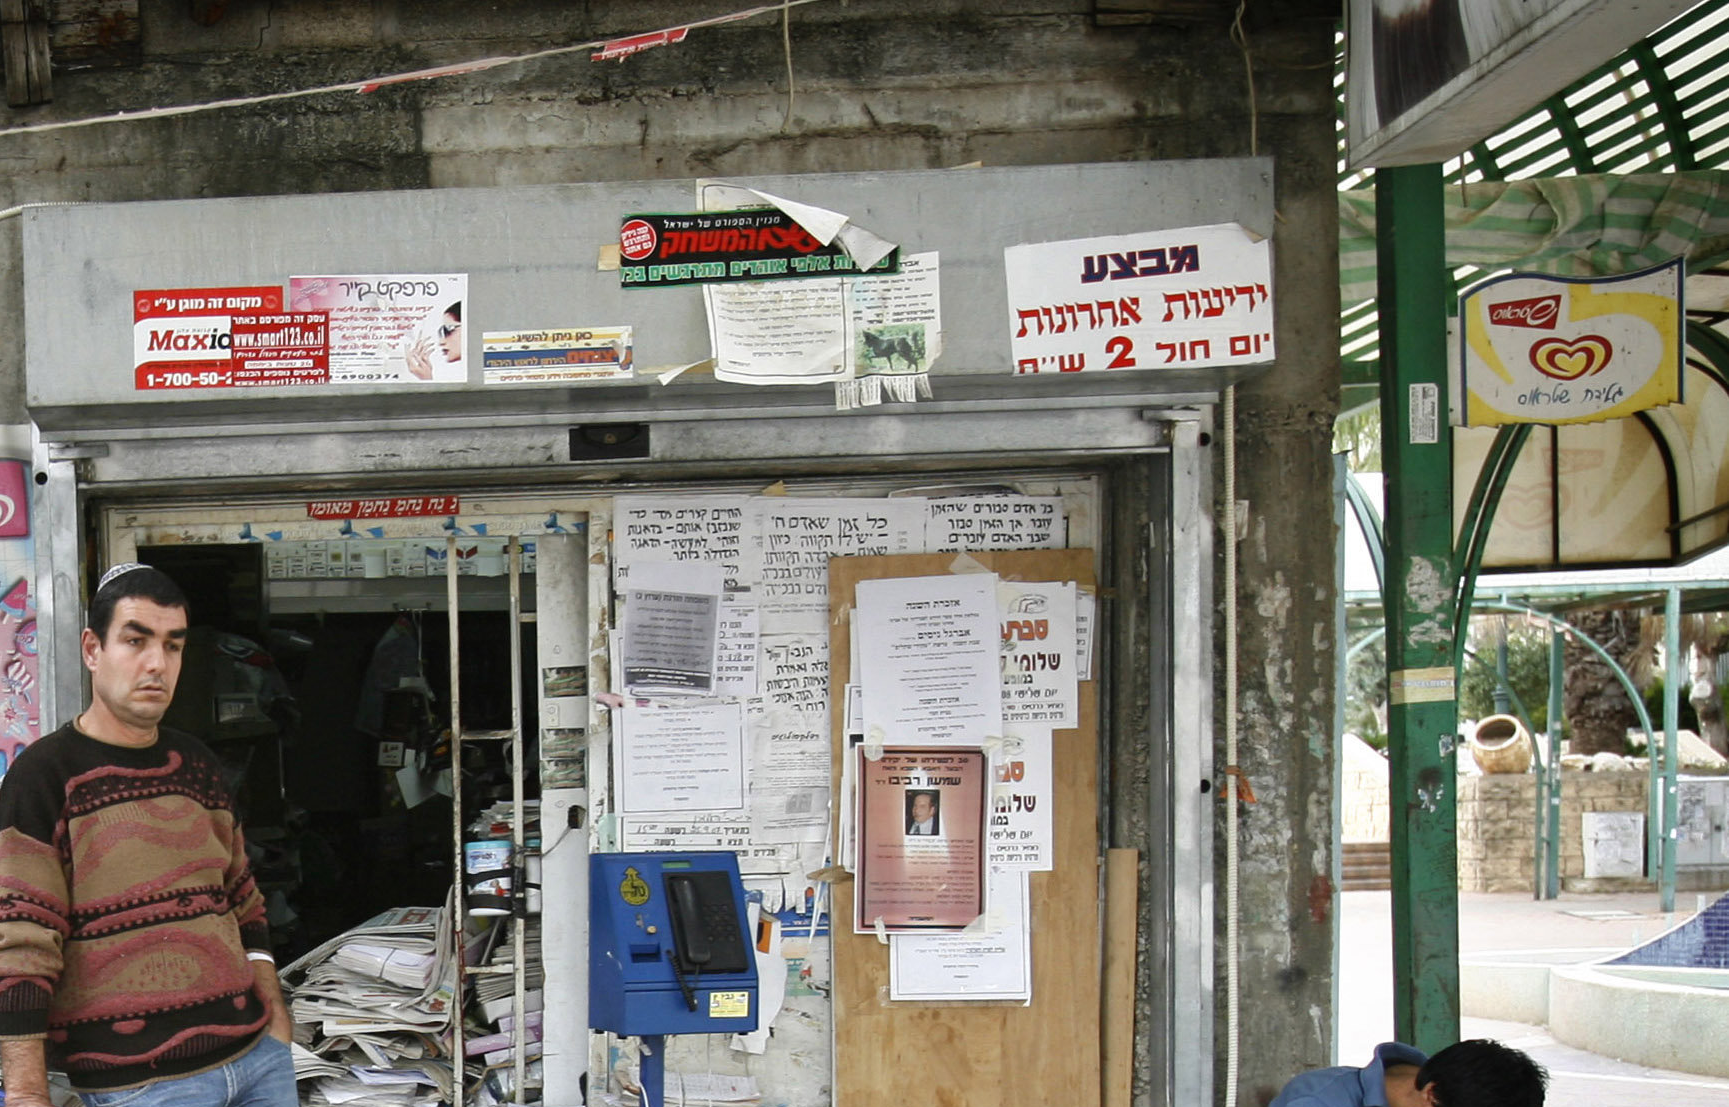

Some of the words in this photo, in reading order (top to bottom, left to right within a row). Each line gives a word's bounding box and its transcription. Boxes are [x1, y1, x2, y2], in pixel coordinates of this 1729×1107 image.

[663, 219, 693, 229] ישראל
[697, 217, 711, 228] של
[1081, 244, 1200, 284] מבצע
[178, 299, 204, 312] מוגן
[207, 298, 223, 309] זה
[226, 296, 263, 310] מקום
[1161, 283, 1269, 322] ידיעות
[232, 316, 257, 325] באתר
[293, 315, 305, 324] זה
[1016, 297, 1143, 339] אחרונות
[233, 325, 325, 347] www.smart123.co.il
[552, 332, 573, 344] ניתן
[1229, 333, 1270, 357] יום
[1105, 336, 1136, 371] 2
[1155, 339, 1211, 364] חול
[711, 508, 742, 521] החיים
[973, 503, 1009, 514] סבורים
[1013, 503, 1036, 514] אדם
[866, 512, 888, 530] כל
[948, 518, 973, 529] סבור
[979, 518, 1004, 534] הזמן
[1009, 519, 1023, 532] אך
[991, 533, 1022, 543] האדם
[1014, 651, 1061, 672] שלומי
[1014, 686, 1041, 699] שלישי
[1044, 689, 1059, 699] יום
[805, 701, 826, 711] רוח
[888, 776, 921, 786] רביבו
[927, 775, 962, 787] שמעון
[1019, 831, 1033, 840] יום
